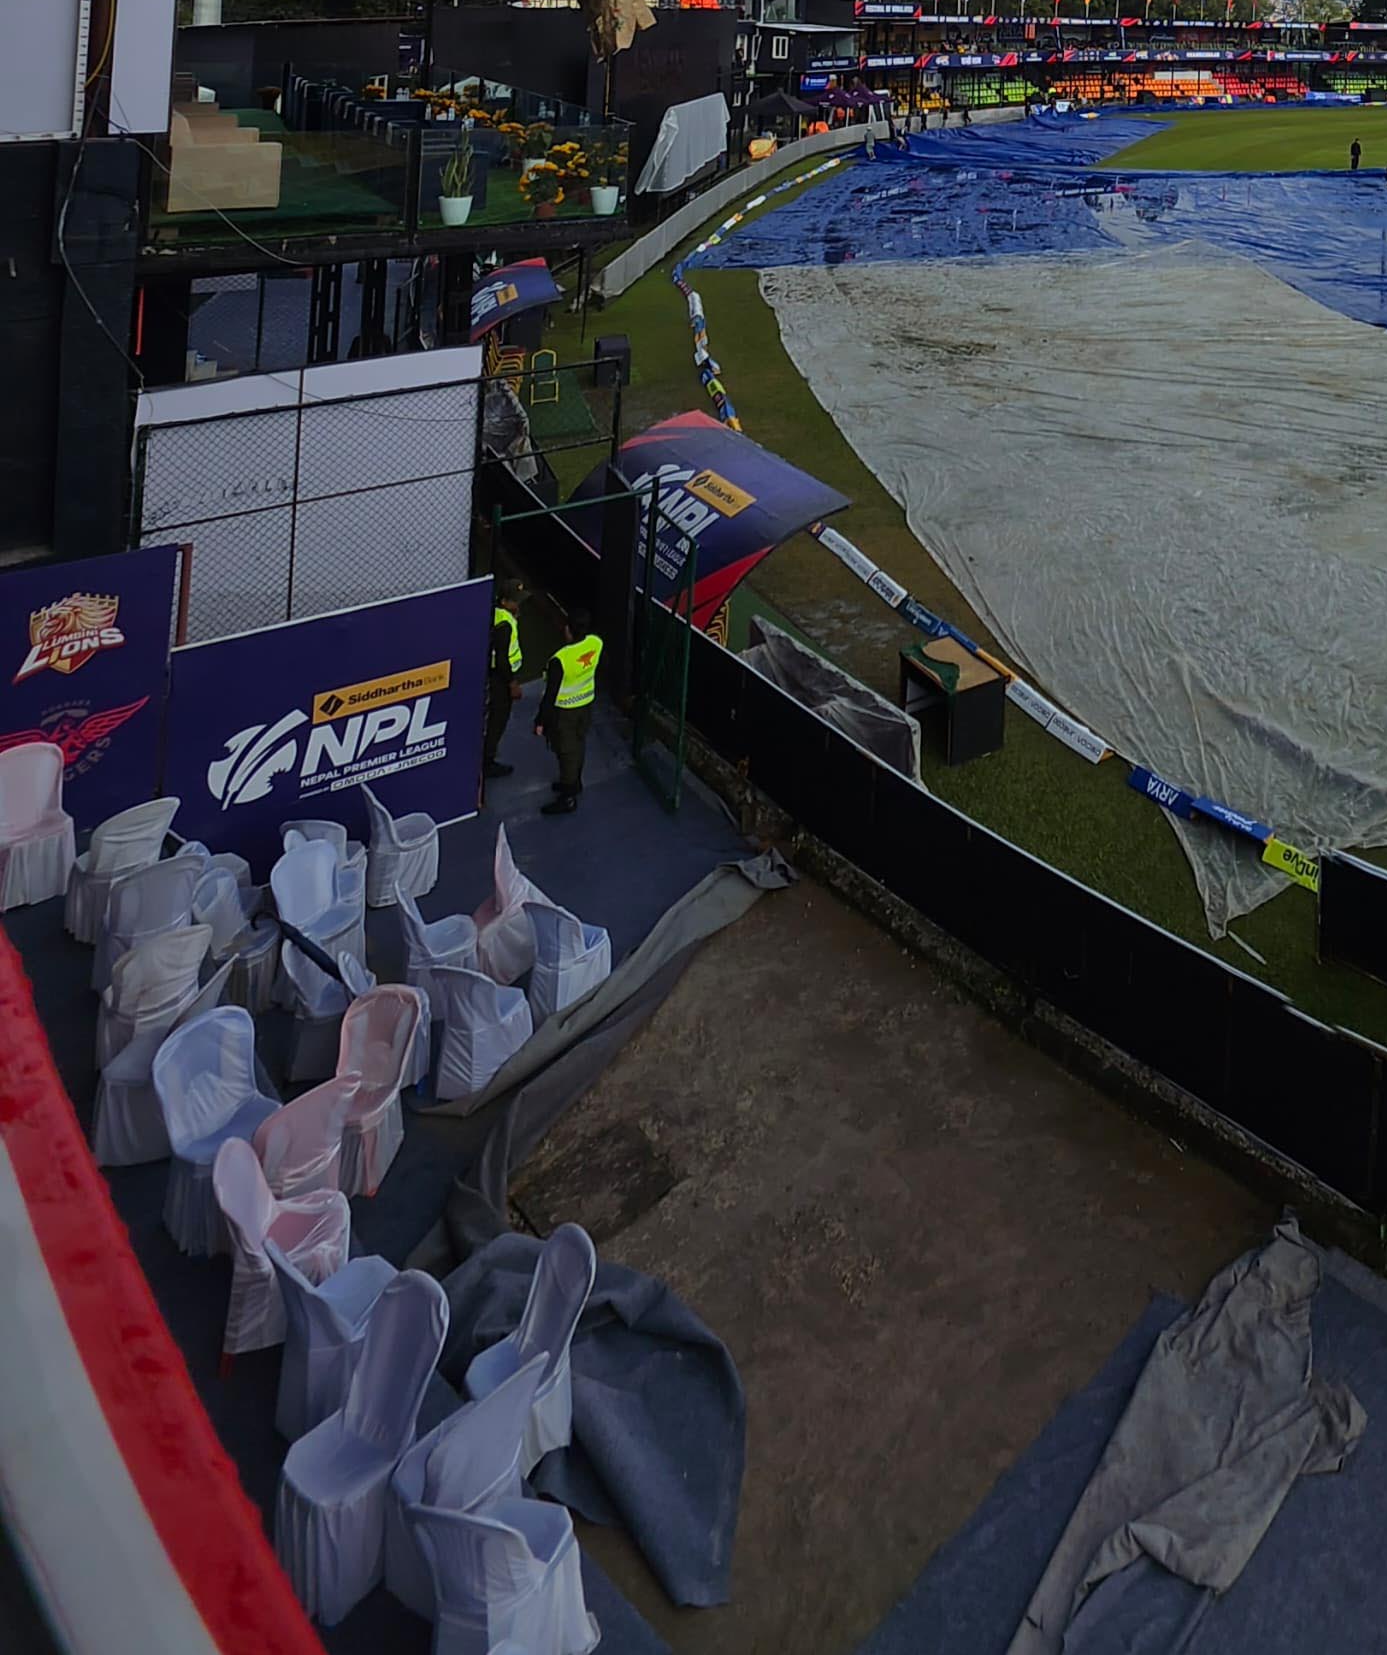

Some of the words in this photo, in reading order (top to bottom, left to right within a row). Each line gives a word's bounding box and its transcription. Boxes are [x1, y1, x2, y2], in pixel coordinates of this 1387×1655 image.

[300, 696, 448, 777] NPL
[300, 768, 341, 788] NEPAL
[344, 752, 397, 775] PREMIER
[400, 737, 445, 757] LEAGUE
[1147, 774, 1179, 806] ARYA
